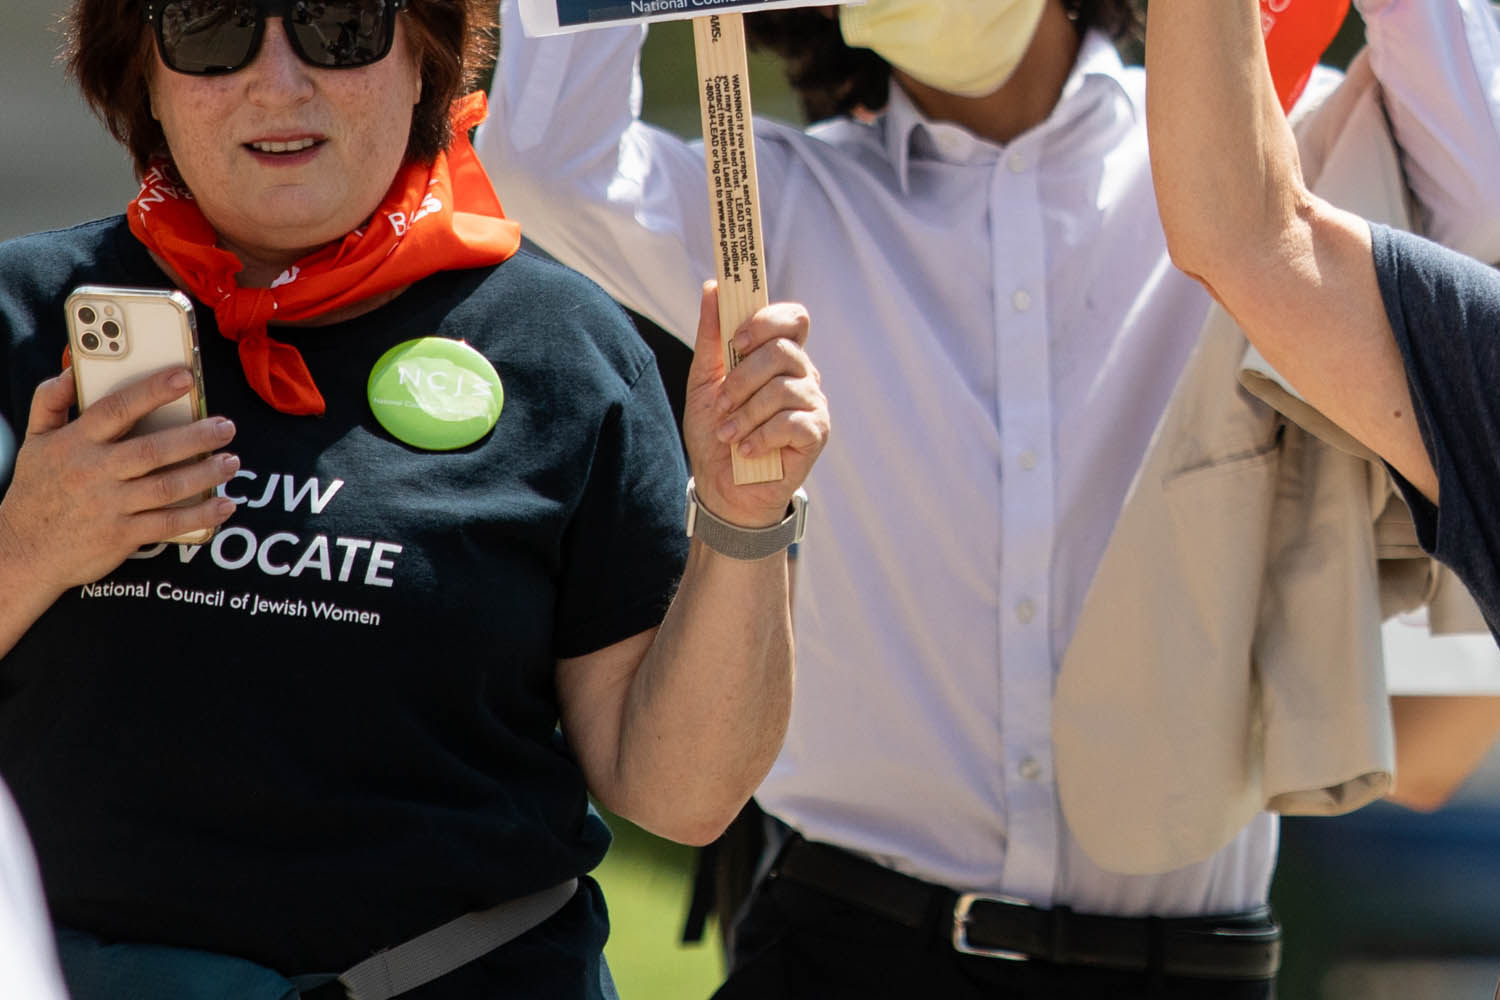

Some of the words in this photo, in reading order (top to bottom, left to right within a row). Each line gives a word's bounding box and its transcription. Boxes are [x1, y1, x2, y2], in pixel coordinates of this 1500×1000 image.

[713, 75, 725, 111] Contact
[722, 75, 731, 92] you
[723, 94, 732, 113] may
[731, 73, 743, 121] WARNING!
[704, 77, 719, 147] 1-800-424-LEAD
[717, 112, 725, 127] the
[726, 114, 735, 146] release
[735, 131, 744, 148] you
[719, 128, 730, 164] National
[730, 148, 739, 166] lead
[712, 160, 721, 174] log
[722, 166, 732, 188] Lead
[738, 150, 747, 182] scrape,
[714, 176, 721, 187] on
[731, 168, 740, 190] dust.
[742, 183, 752, 205] sand
[725, 189, 736, 239] Information
[734, 197, 744, 222] LEAD
[746, 218, 754, 250] remove
[730, 240, 739, 272] Hotline
[738, 234, 748, 264] TOXIC.
[749, 252, 758, 266] old
[749, 268, 760, 292] paint,
[216, 469, 345, 515] CJW
[81, 580, 150, 600] National
[156, 582, 224, 608] Council
[230, 593, 250, 611] of
[250, 594, 308, 618] Jewish
[311, 601, 381, 627] Women
